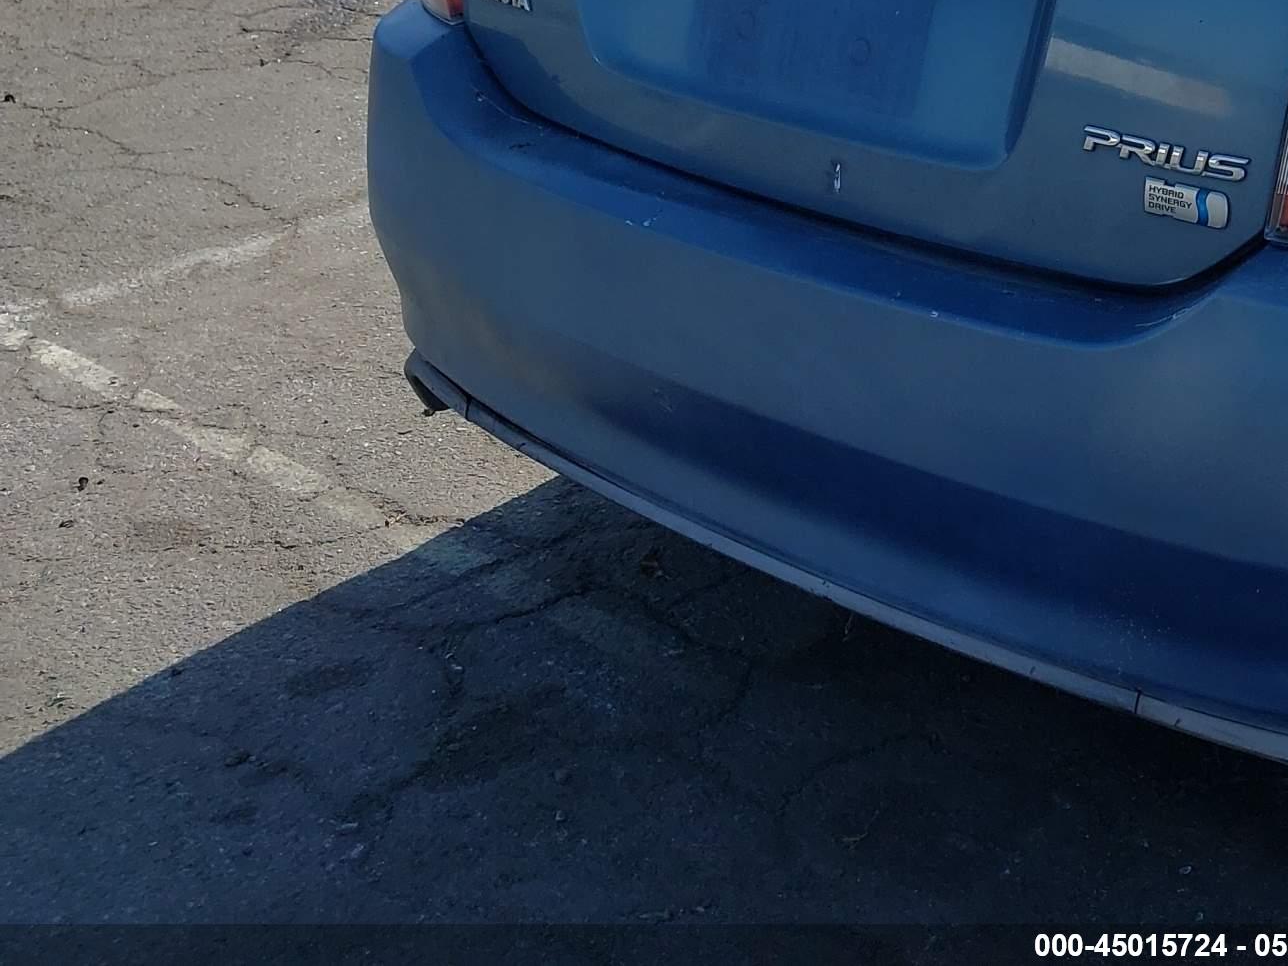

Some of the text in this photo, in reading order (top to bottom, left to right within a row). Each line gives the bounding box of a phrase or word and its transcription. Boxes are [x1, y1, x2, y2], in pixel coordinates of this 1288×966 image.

[1083, 124, 1250, 182] PRIUS
[1148, 184, 1184, 199] HYBRID
[1148, 193, 1192, 209] SYNERGY
[1148, 201, 1176, 214] DRIVE
